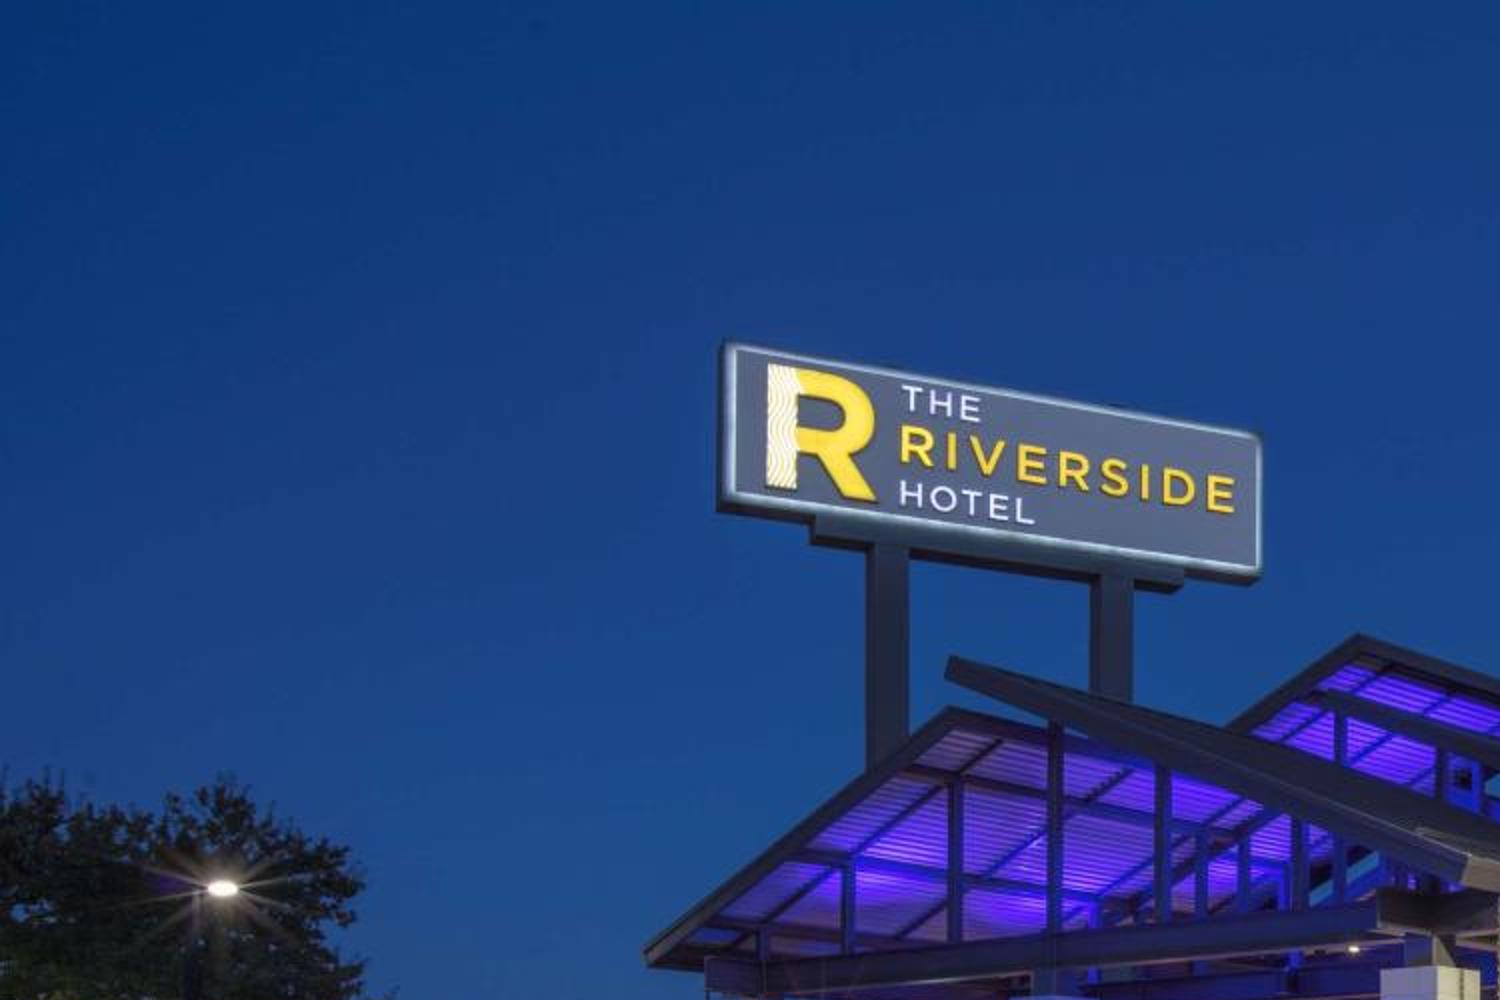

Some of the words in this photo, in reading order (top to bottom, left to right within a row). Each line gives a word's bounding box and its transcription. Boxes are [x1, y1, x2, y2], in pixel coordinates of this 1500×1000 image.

[766, 363, 877, 501] R
[901, 384, 981, 422] THE
[901, 424, 1235, 513] RIVERSIDE
[900, 480, 1036, 525] HOTEL
